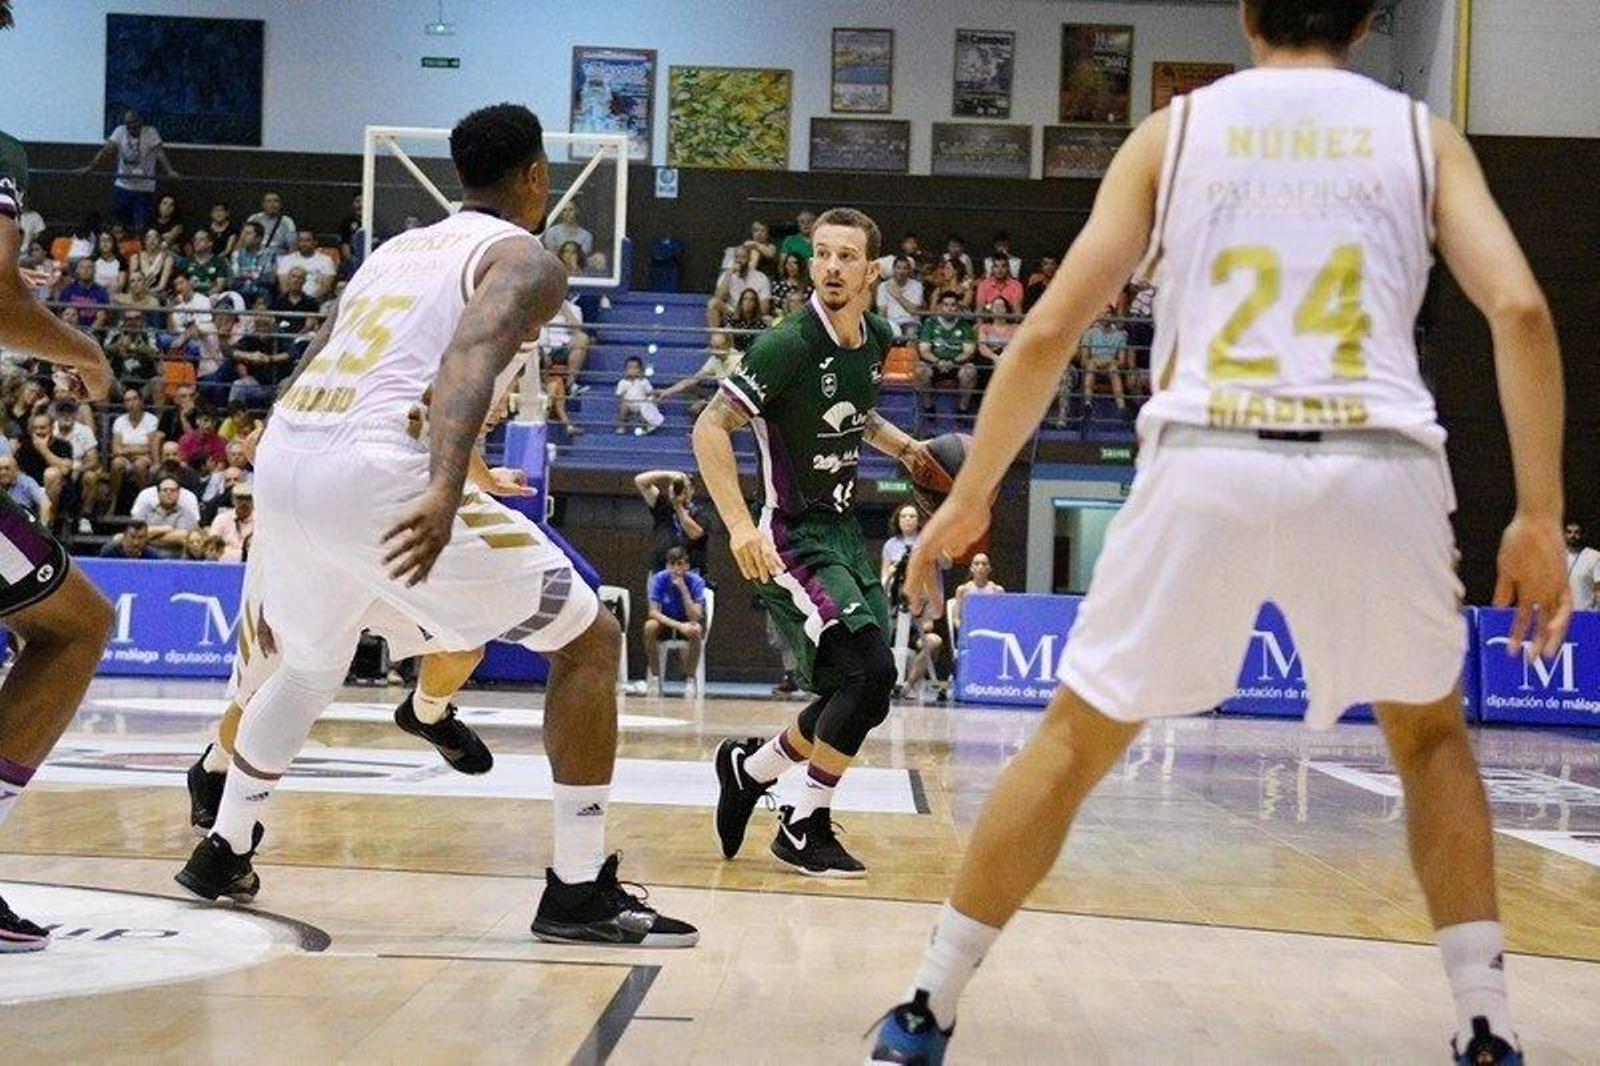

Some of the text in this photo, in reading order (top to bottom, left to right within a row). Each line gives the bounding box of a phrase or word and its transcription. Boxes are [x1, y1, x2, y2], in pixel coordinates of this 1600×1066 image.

[1226, 119, 1374, 160] NÚÑEZ
[1207, 243, 1372, 381] 24
[115, 649, 159, 664] málaga
[165, 649, 221, 664] diputación
[967, 629, 1059, 682] M
[965, 683, 1020, 698] diputación
[1023, 686, 1037, 698] de
[1285, 688, 1299, 698] de
[1486, 693, 1544, 709] diputación
[1545, 696, 1560, 709] de
